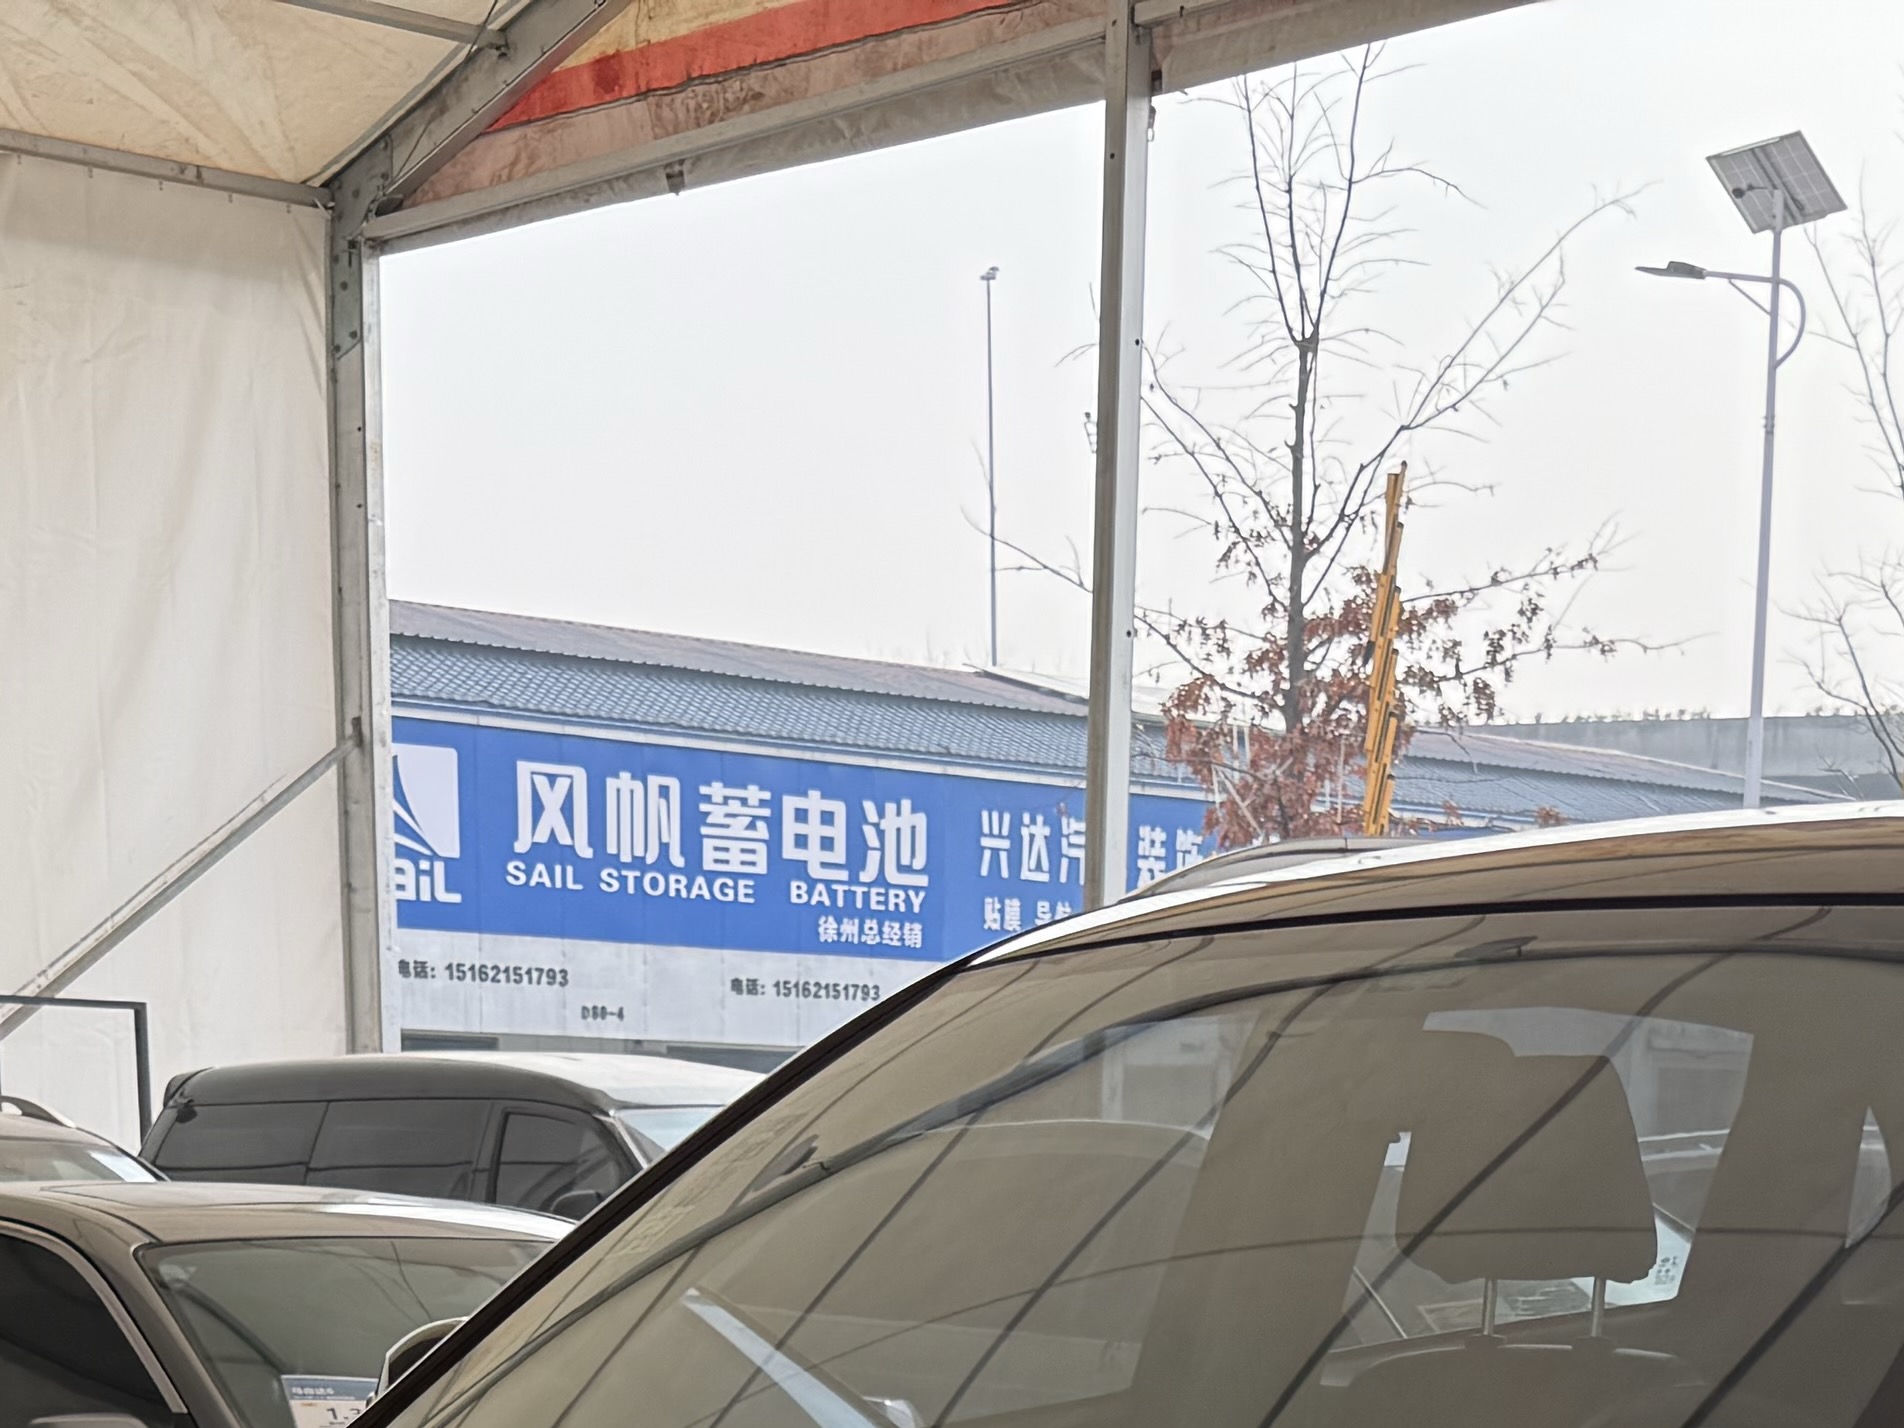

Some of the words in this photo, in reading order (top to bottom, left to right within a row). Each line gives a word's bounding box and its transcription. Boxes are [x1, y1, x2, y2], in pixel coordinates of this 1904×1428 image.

[513, 759, 928, 888] 风帆蓄电池
[506, 860, 584, 891] SAIL
[599, 868, 756, 904] STORAGE
[789, 880, 926, 914] BATTERY
[817, 914, 923, 949] 徐州总经销
[444, 961, 570, 988] 15162151793
[773, 979, 881, 1002] 15162151793
